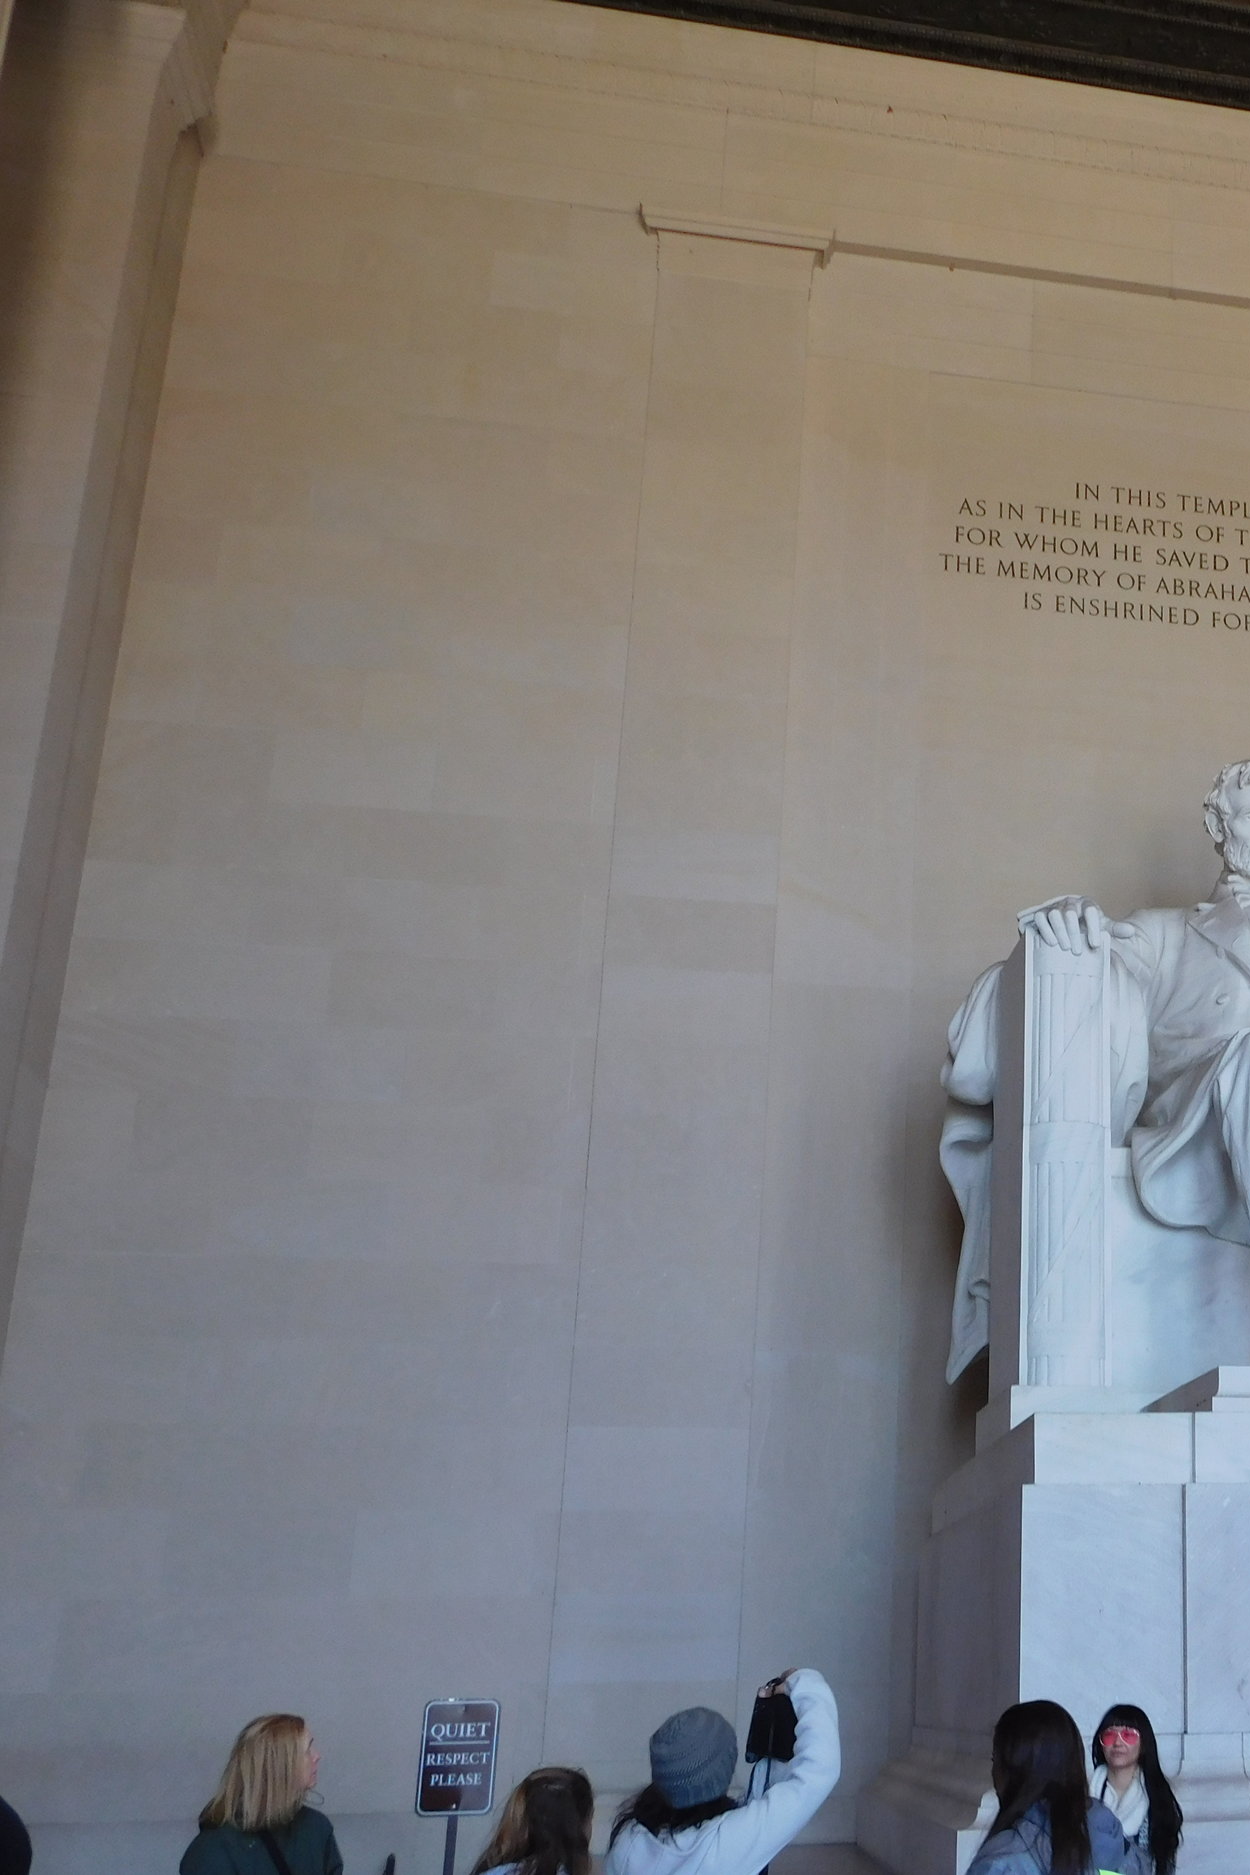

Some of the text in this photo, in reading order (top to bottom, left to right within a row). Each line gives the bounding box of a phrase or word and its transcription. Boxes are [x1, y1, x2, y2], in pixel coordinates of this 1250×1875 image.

[1075, 481, 1100, 502] IN
[1110, 485, 1167, 510] THIS
[958, 497, 987, 518] AS
[998, 501, 1024, 521] IN
[1034, 505, 1082, 529] THE
[1093, 512, 1184, 540] HEARTS
[1195, 524, 1225, 544] OF
[955, 525, 1004, 549] FOR
[1013, 531, 1100, 559] WHOM
[1113, 542, 1143, 564] HE
[1155, 547, 1230, 573] SAVED
[938, 552, 986, 576] THE
[996, 559, 1107, 588] MEMORY
[1116, 571, 1147, 592] OF
[1023, 591, 1043, 611] IS
[1055, 594, 1200, 627] ENSHRINED
[430, 1721, 491, 1741] QUIET
[426, 1751, 490, 1767] RESPECT
[430, 1772, 482, 1787] PLEASE
